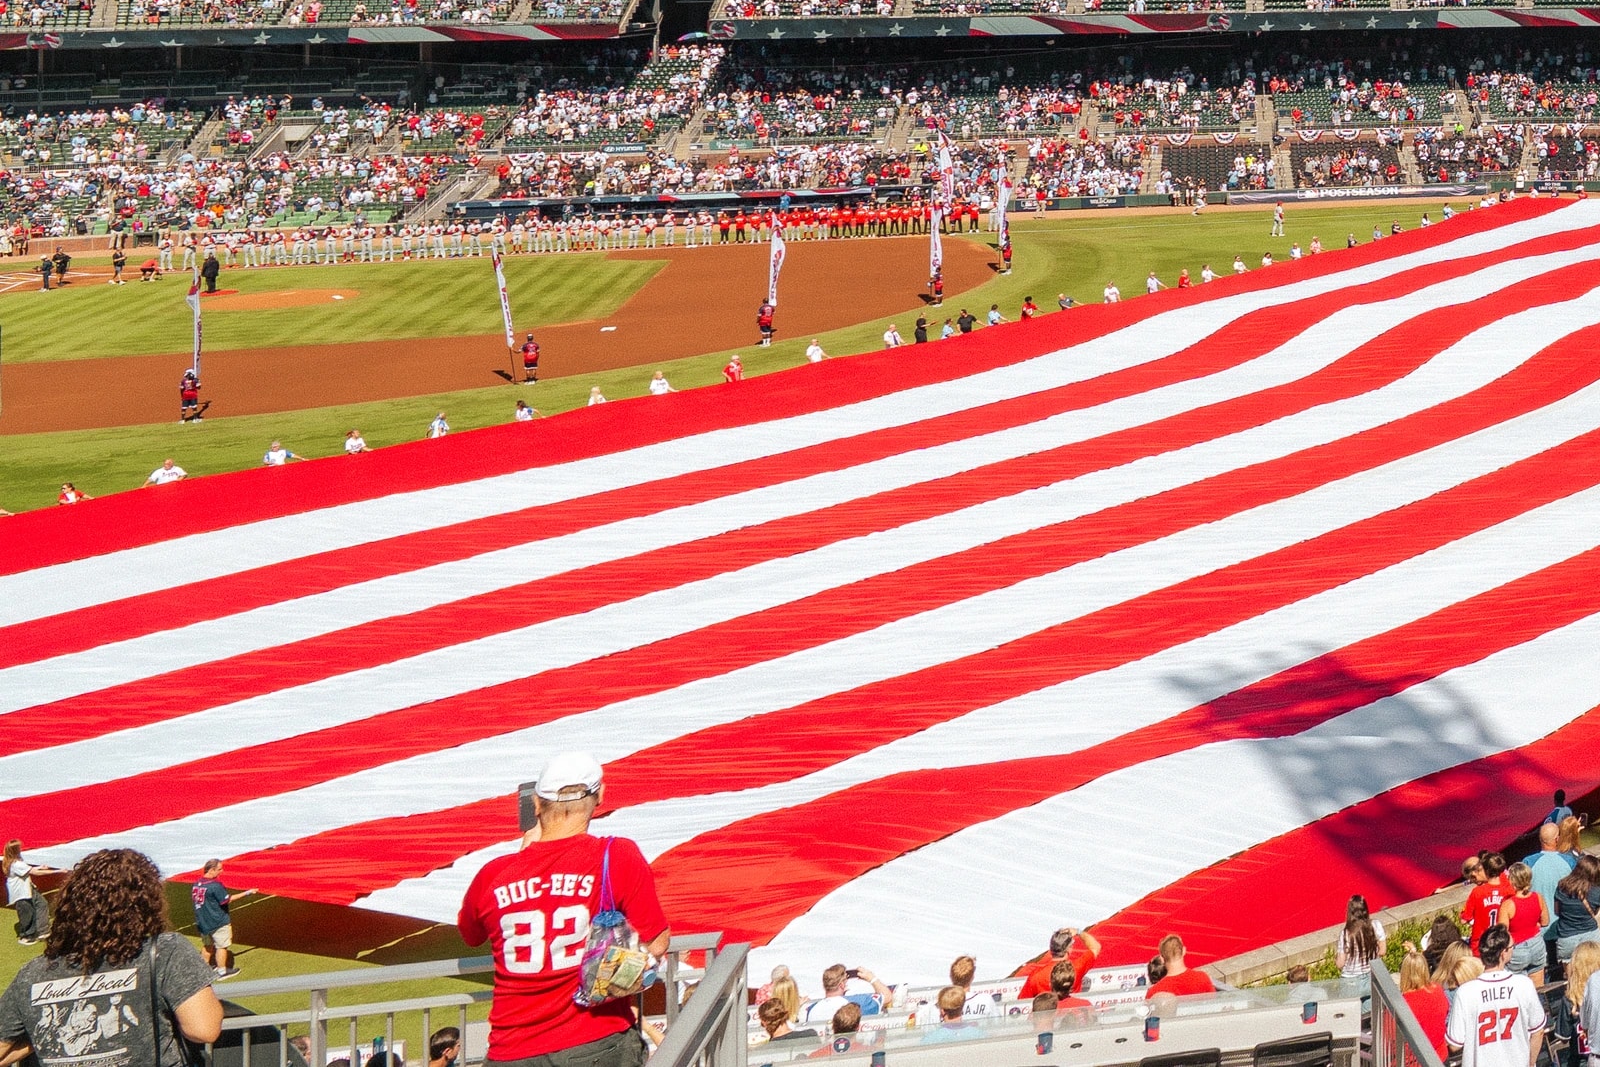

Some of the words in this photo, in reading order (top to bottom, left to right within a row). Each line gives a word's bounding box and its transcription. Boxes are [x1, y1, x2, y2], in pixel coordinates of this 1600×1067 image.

[1319, 187, 1399, 197] POSTSEASON
[493, 873, 595, 909] BUC-EE'S
[500, 904, 591, 974] 82
[32, 980, 77, 1004] Loud
[79, 970, 137, 998] Local
[1481, 986, 1514, 1003] RILEY
[1478, 1007, 1518, 1046] 27
